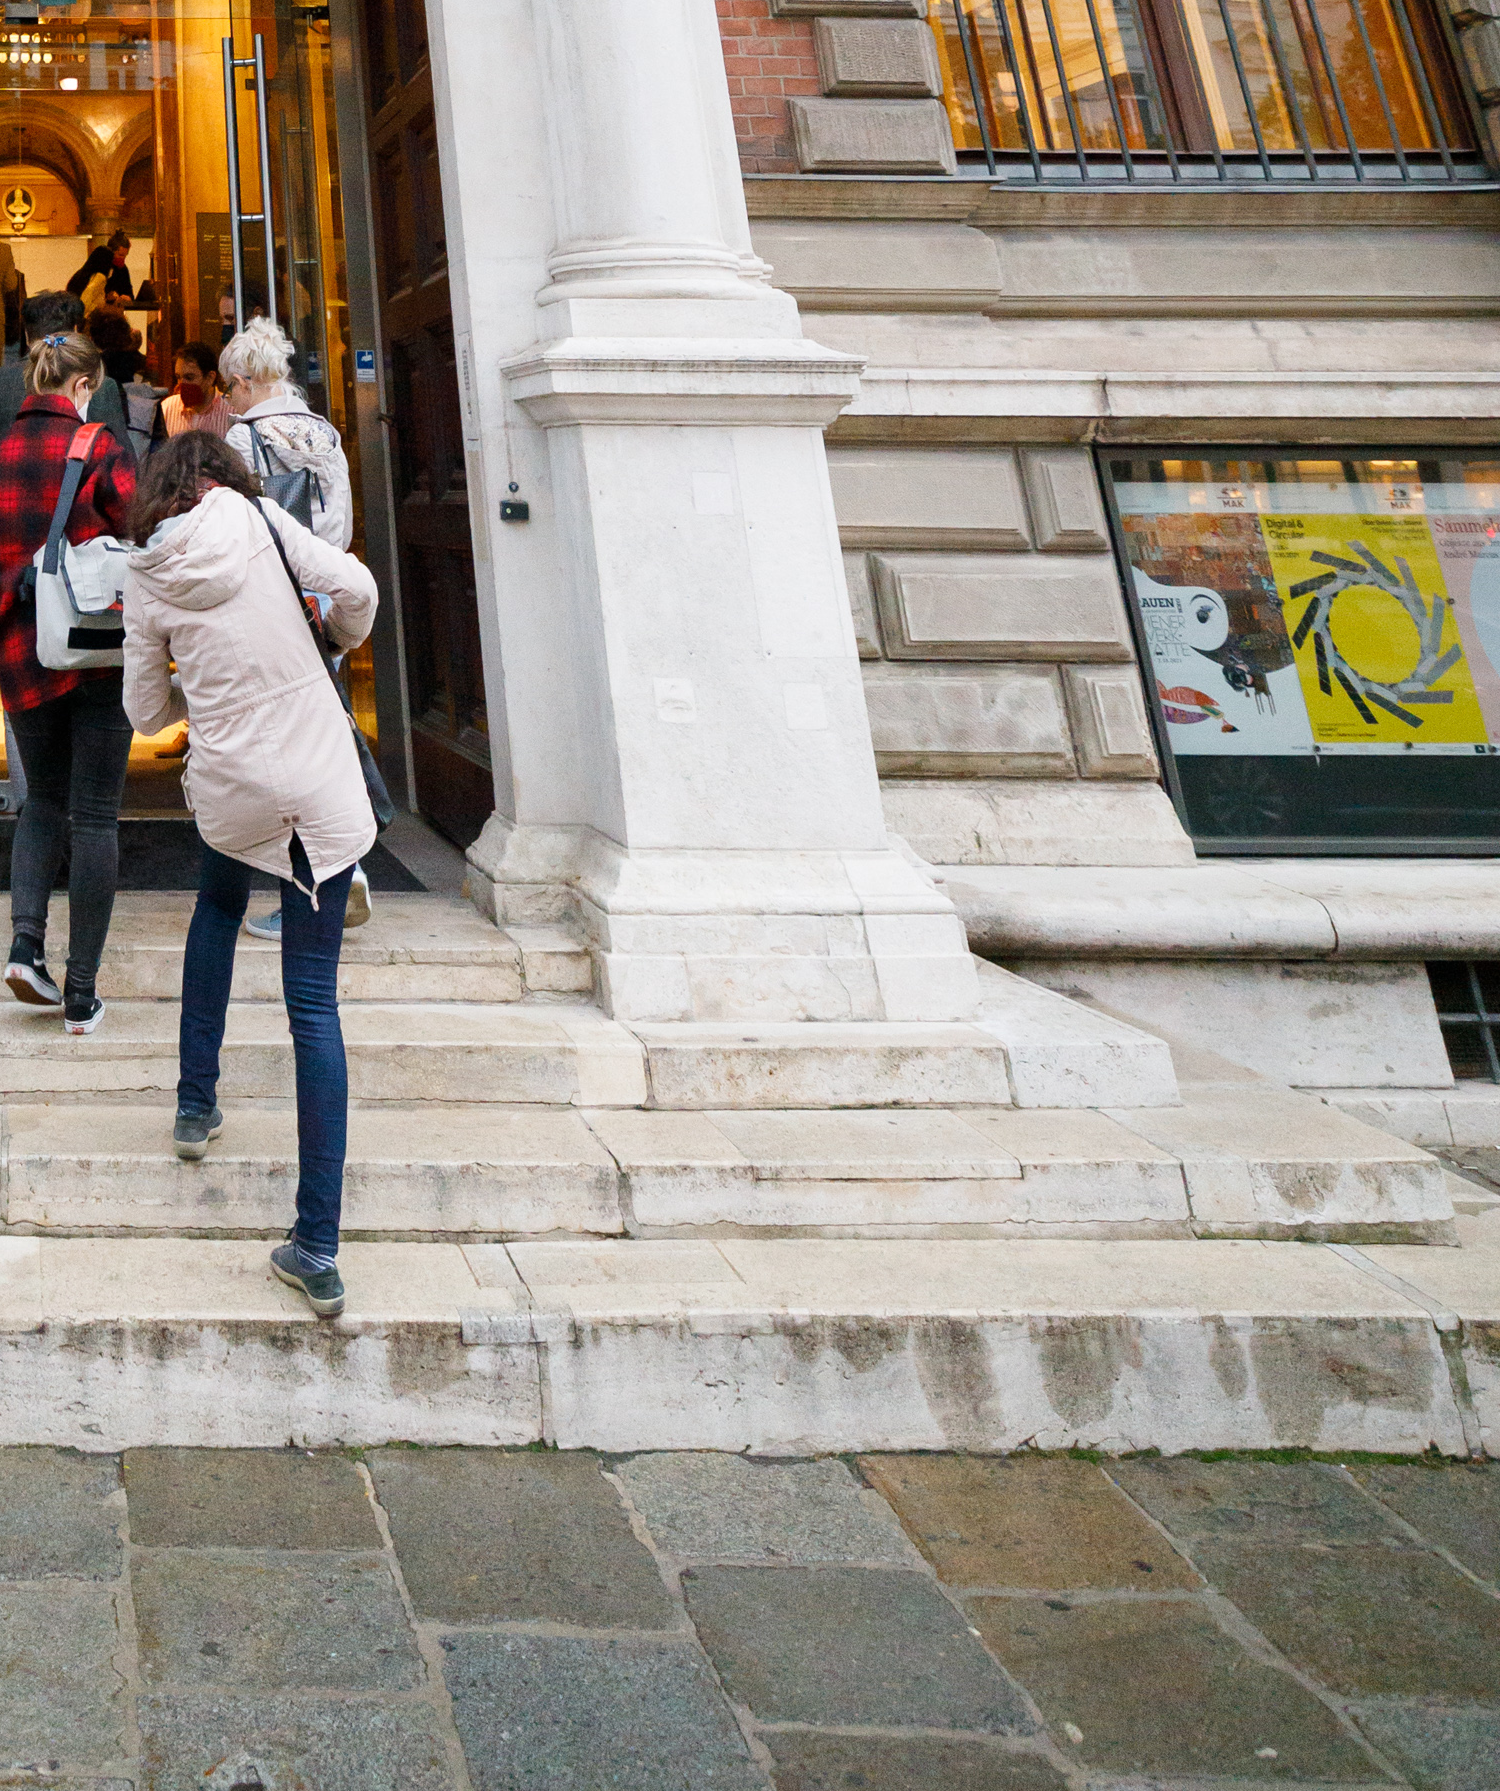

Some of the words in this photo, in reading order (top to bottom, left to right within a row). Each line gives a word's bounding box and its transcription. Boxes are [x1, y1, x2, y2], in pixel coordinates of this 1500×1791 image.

[1221, 500, 1245, 508] MAK
[1266, 519, 1296, 529] Digital
[1297, 519, 1304, 527] &
[1141, 598, 1174, 607] AUEN
